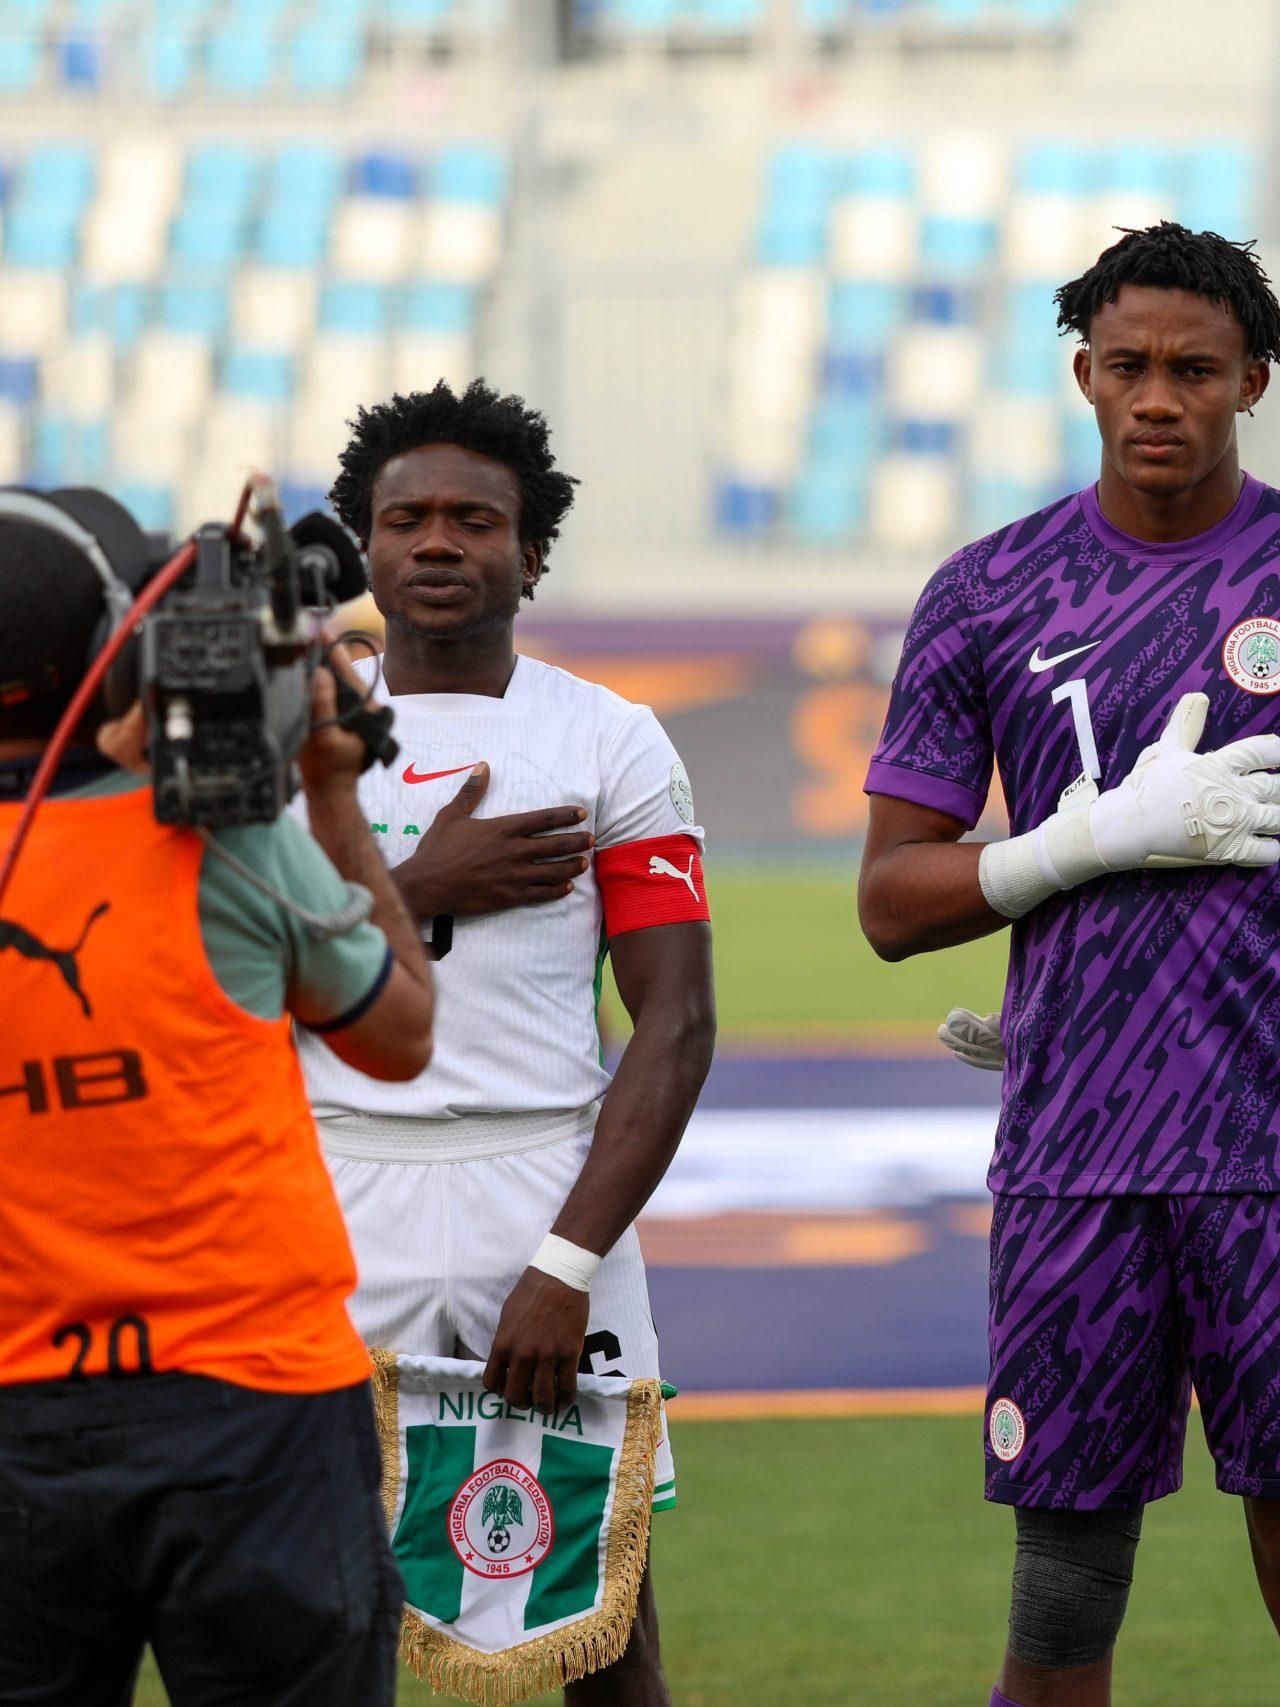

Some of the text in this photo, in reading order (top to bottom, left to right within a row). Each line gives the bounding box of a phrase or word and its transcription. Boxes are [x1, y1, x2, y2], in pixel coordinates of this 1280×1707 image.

[1227, 640, 1240, 675] NIGERIA
[1234, 621, 1279, 639] FOOTBALL
[1249, 681, 1270, 690] 1945
[1051, 679, 1101, 779] 1
[1064, 774, 1087, 796] ELITE
[452, 1464, 550, 1548] NIGERIA FOOTBALL FEDERATION
[486, 1563, 510, 1574] 1945
